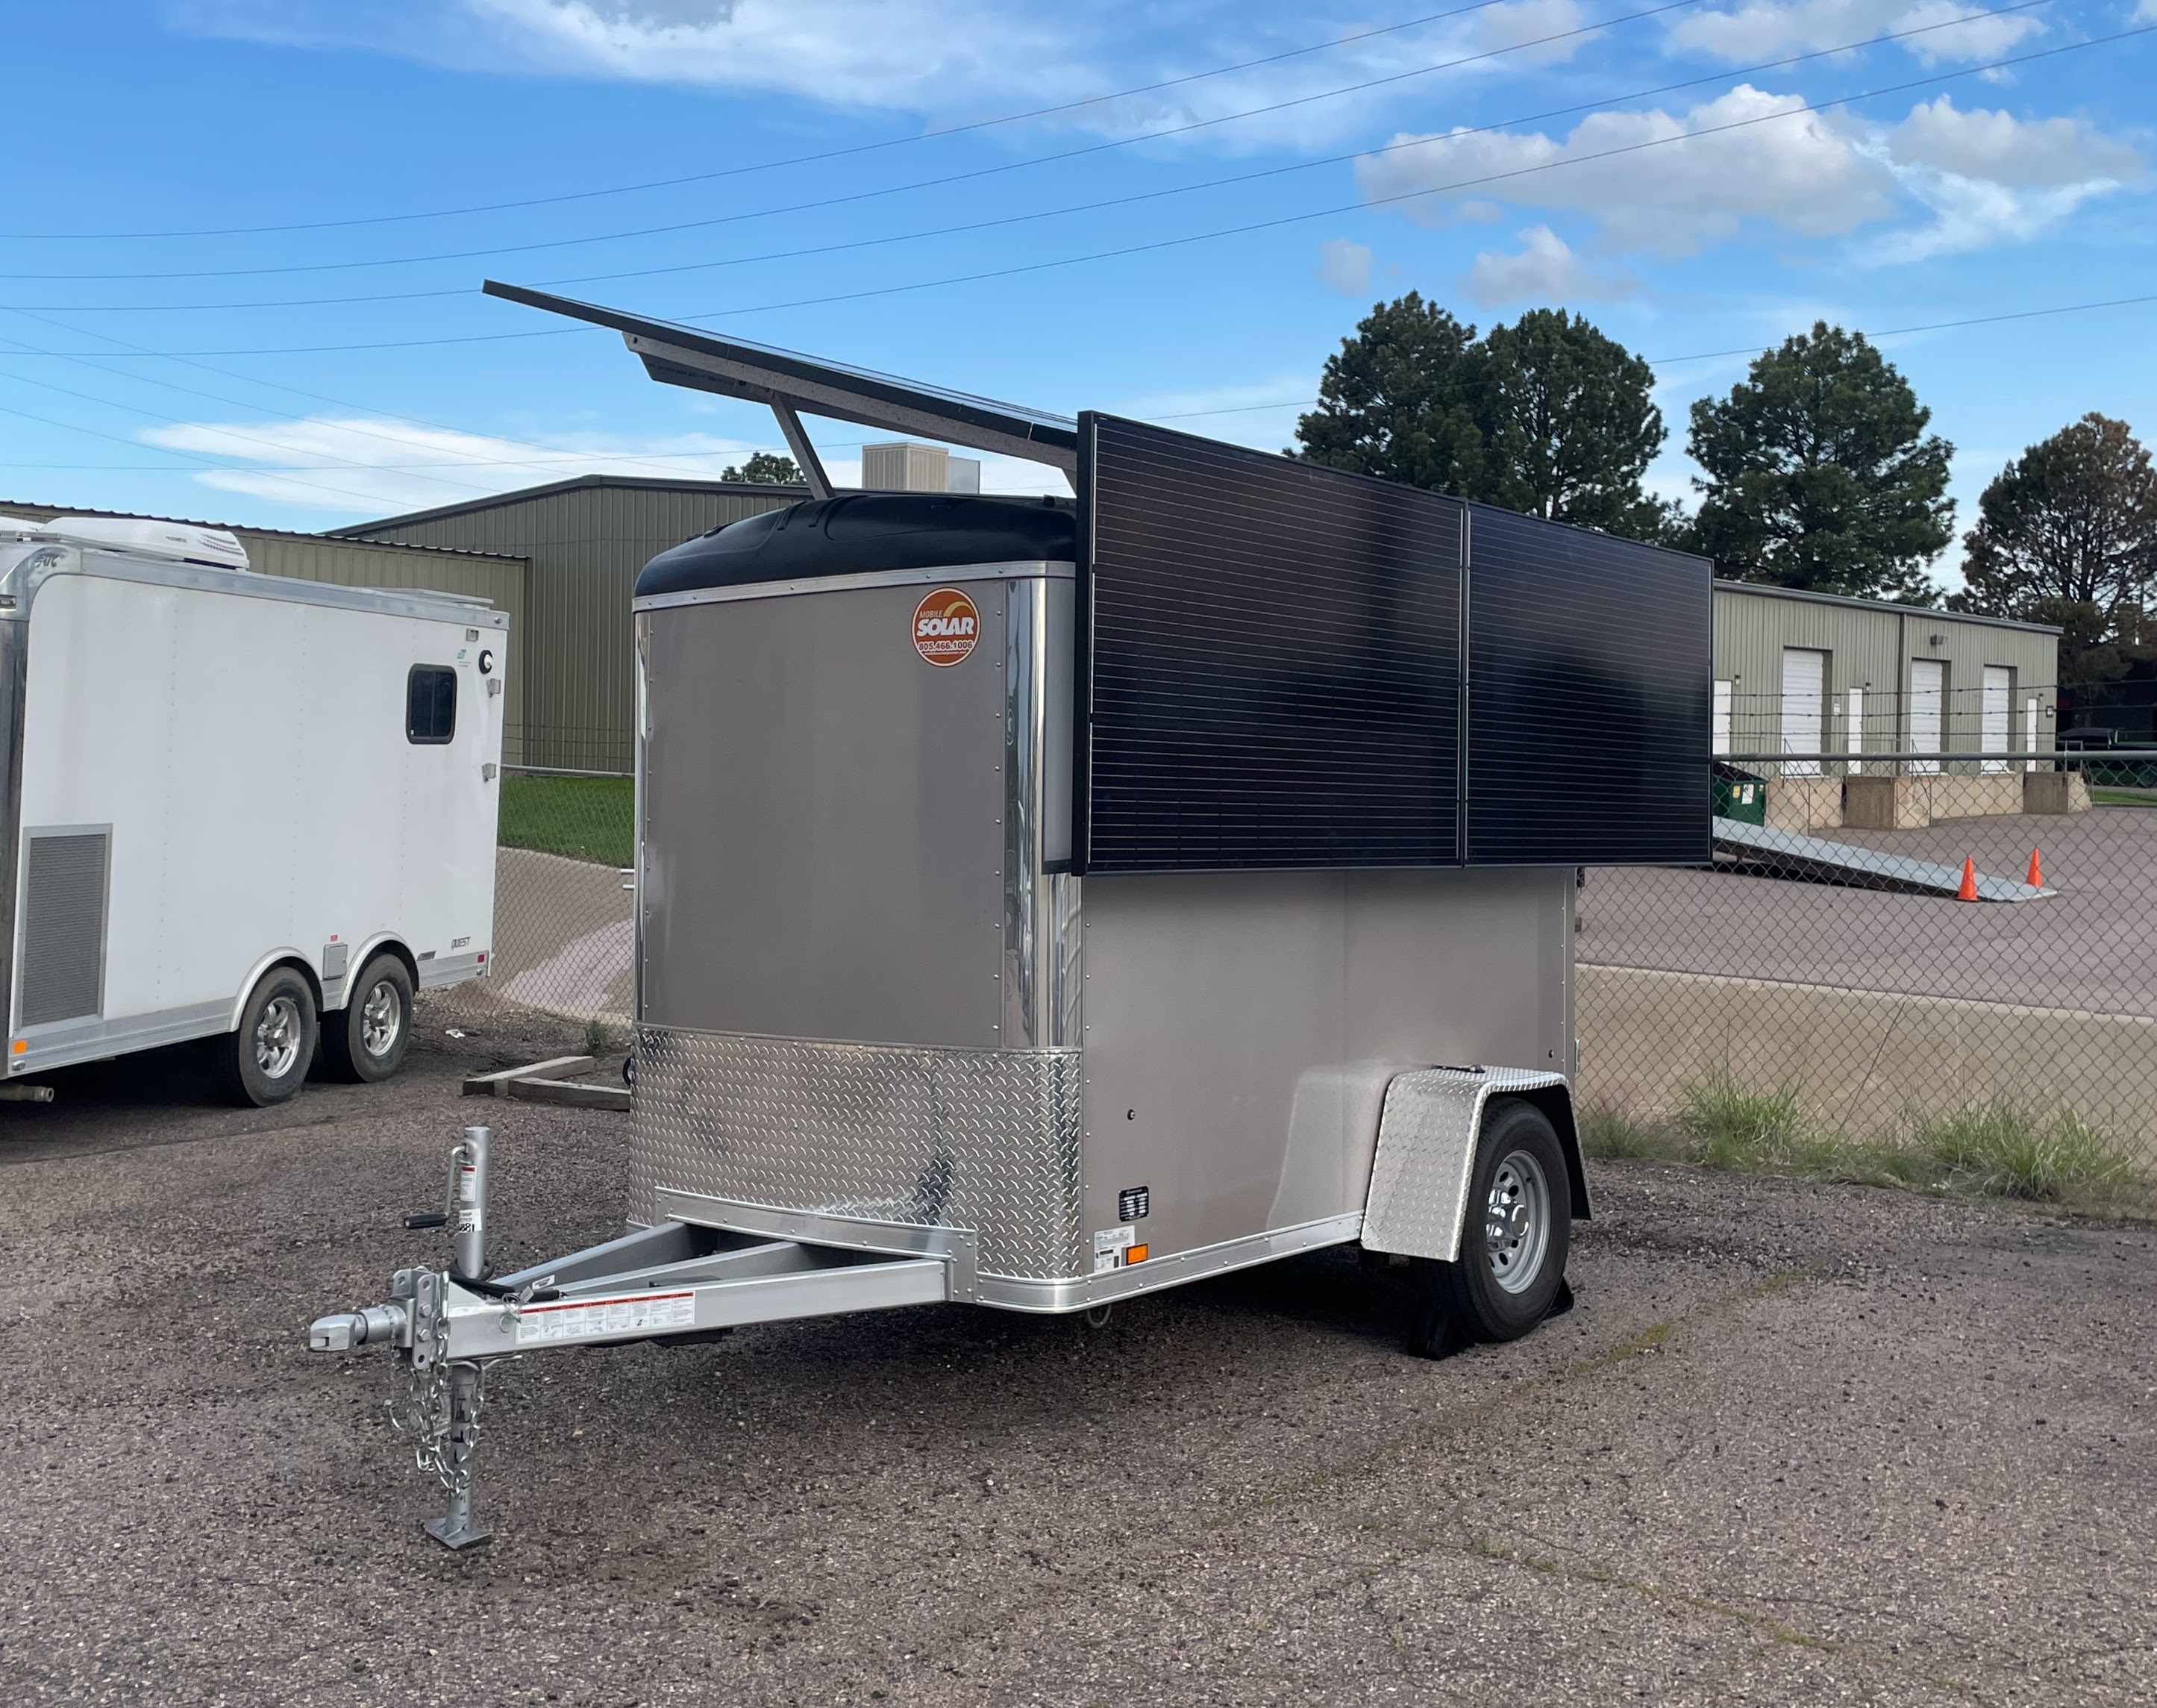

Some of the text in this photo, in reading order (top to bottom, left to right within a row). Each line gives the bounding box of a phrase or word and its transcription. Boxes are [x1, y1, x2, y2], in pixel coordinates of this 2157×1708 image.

[919, 610, 943, 619] MOBILE
[917, 616, 974, 636] SOLAR
[918, 640, 973, 651] 805.466.1006
[451, 936, 471, 951] QUEST
